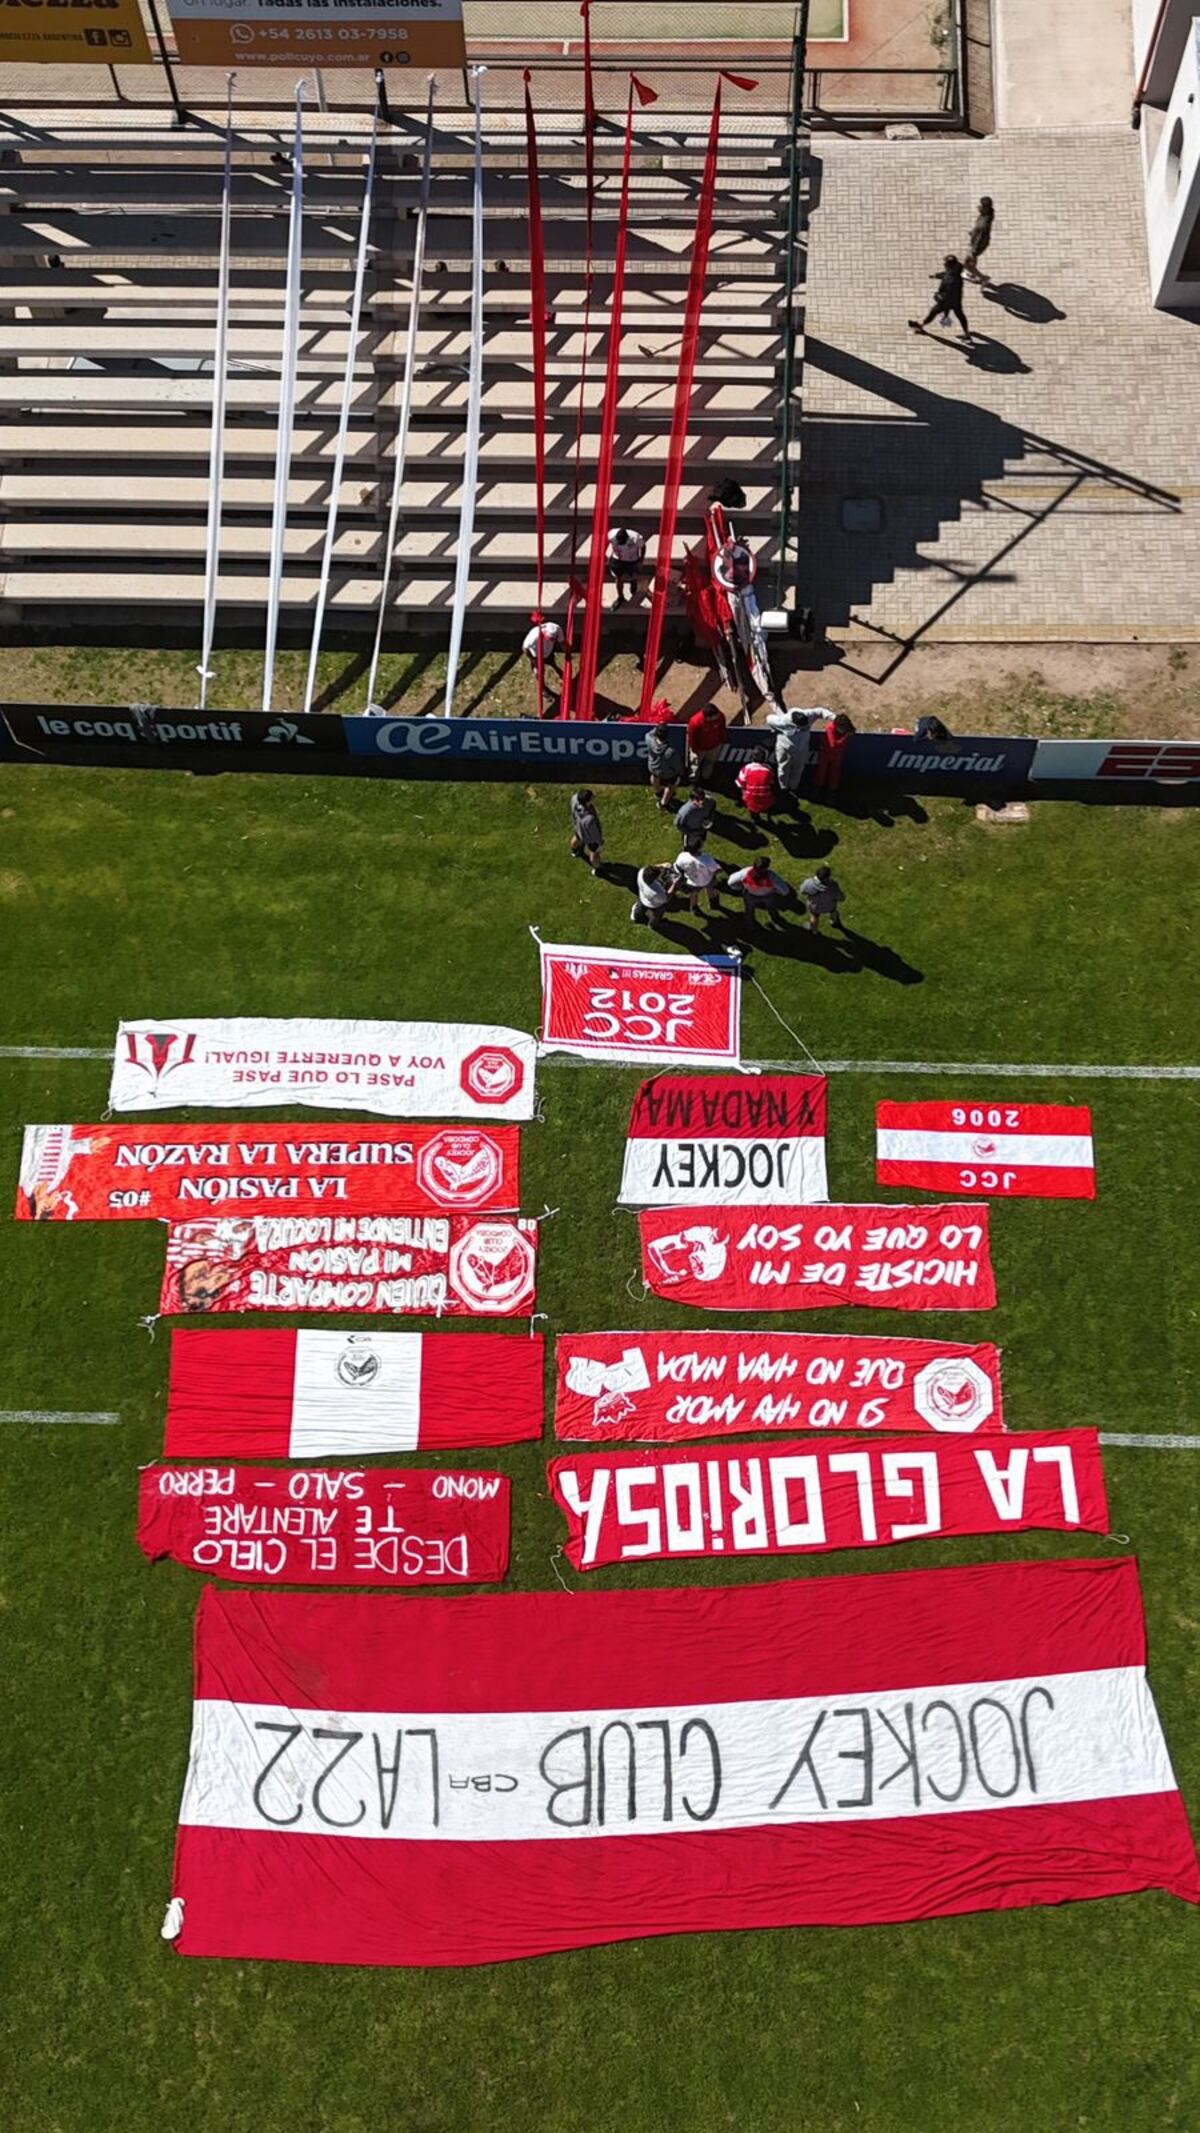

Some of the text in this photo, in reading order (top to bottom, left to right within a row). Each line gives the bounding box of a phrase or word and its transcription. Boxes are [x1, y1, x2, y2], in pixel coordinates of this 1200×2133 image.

[259, 28, 409, 40] +54 2613 03-7958
[235, 51, 370, 63] www.policuyo.com.ar
[37, 715, 243, 742] le coq portif
[887, 749, 1006, 773] Imperial
[633, 968, 674, 981] GRACIAS
[588, 987, 696, 1016] 2012
[583, 1011, 694, 1043] JCC
[205, 1051, 445, 1069] VOY A QUERERTE IGUAL!
[232, 1070, 415, 1087] PASE LO QUE PASE
[700, 1090, 787, 1128] NADA
[798, 1091, 814, 1126] Y
[951, 1109, 1019, 1127] 2006
[116, 1141, 413, 1172] SUPERA LA RAZÓN
[652, 1144, 790, 1188] JOCKEY
[178, 1176, 346, 1204] LA PASIÓN
[959, 1170, 1016, 1189] JCC
[109, 1190, 151, 1207] #05
[255, 1217, 448, 1252] ENTIENDE MI LOCURA
[737, 1224, 982, 1250] LO QUE YO SOY
[289, 1248, 412, 1276] MI PASIÓN
[749, 1260, 978, 1291] HICISTE DE MI
[248, 1271, 444, 1311] QUIÉN COMPARTE
[657, 1351, 728, 1382] NADA
[736, 1352, 798, 1384] HAYA
[806, 1357, 844, 1384] NO
[848, 1357, 906, 1388] QUE
[666, 1393, 889, 1428] SI NO HAY AMOR
[159, 1469, 235, 1495] PERRO
[288, 1472, 364, 1499] SALO
[432, 1477, 500, 1498] MONO
[974, 1446, 1079, 1524] LA
[204, 1503, 404, 1535] TE ALENTARE
[192, 1534, 468, 1576] DESDE EL CIELO
[769, 1686, 1054, 1812] JOCKEY
[449, 1773, 519, 1794] CBA
[540, 1717, 722, 1828] CLUB
